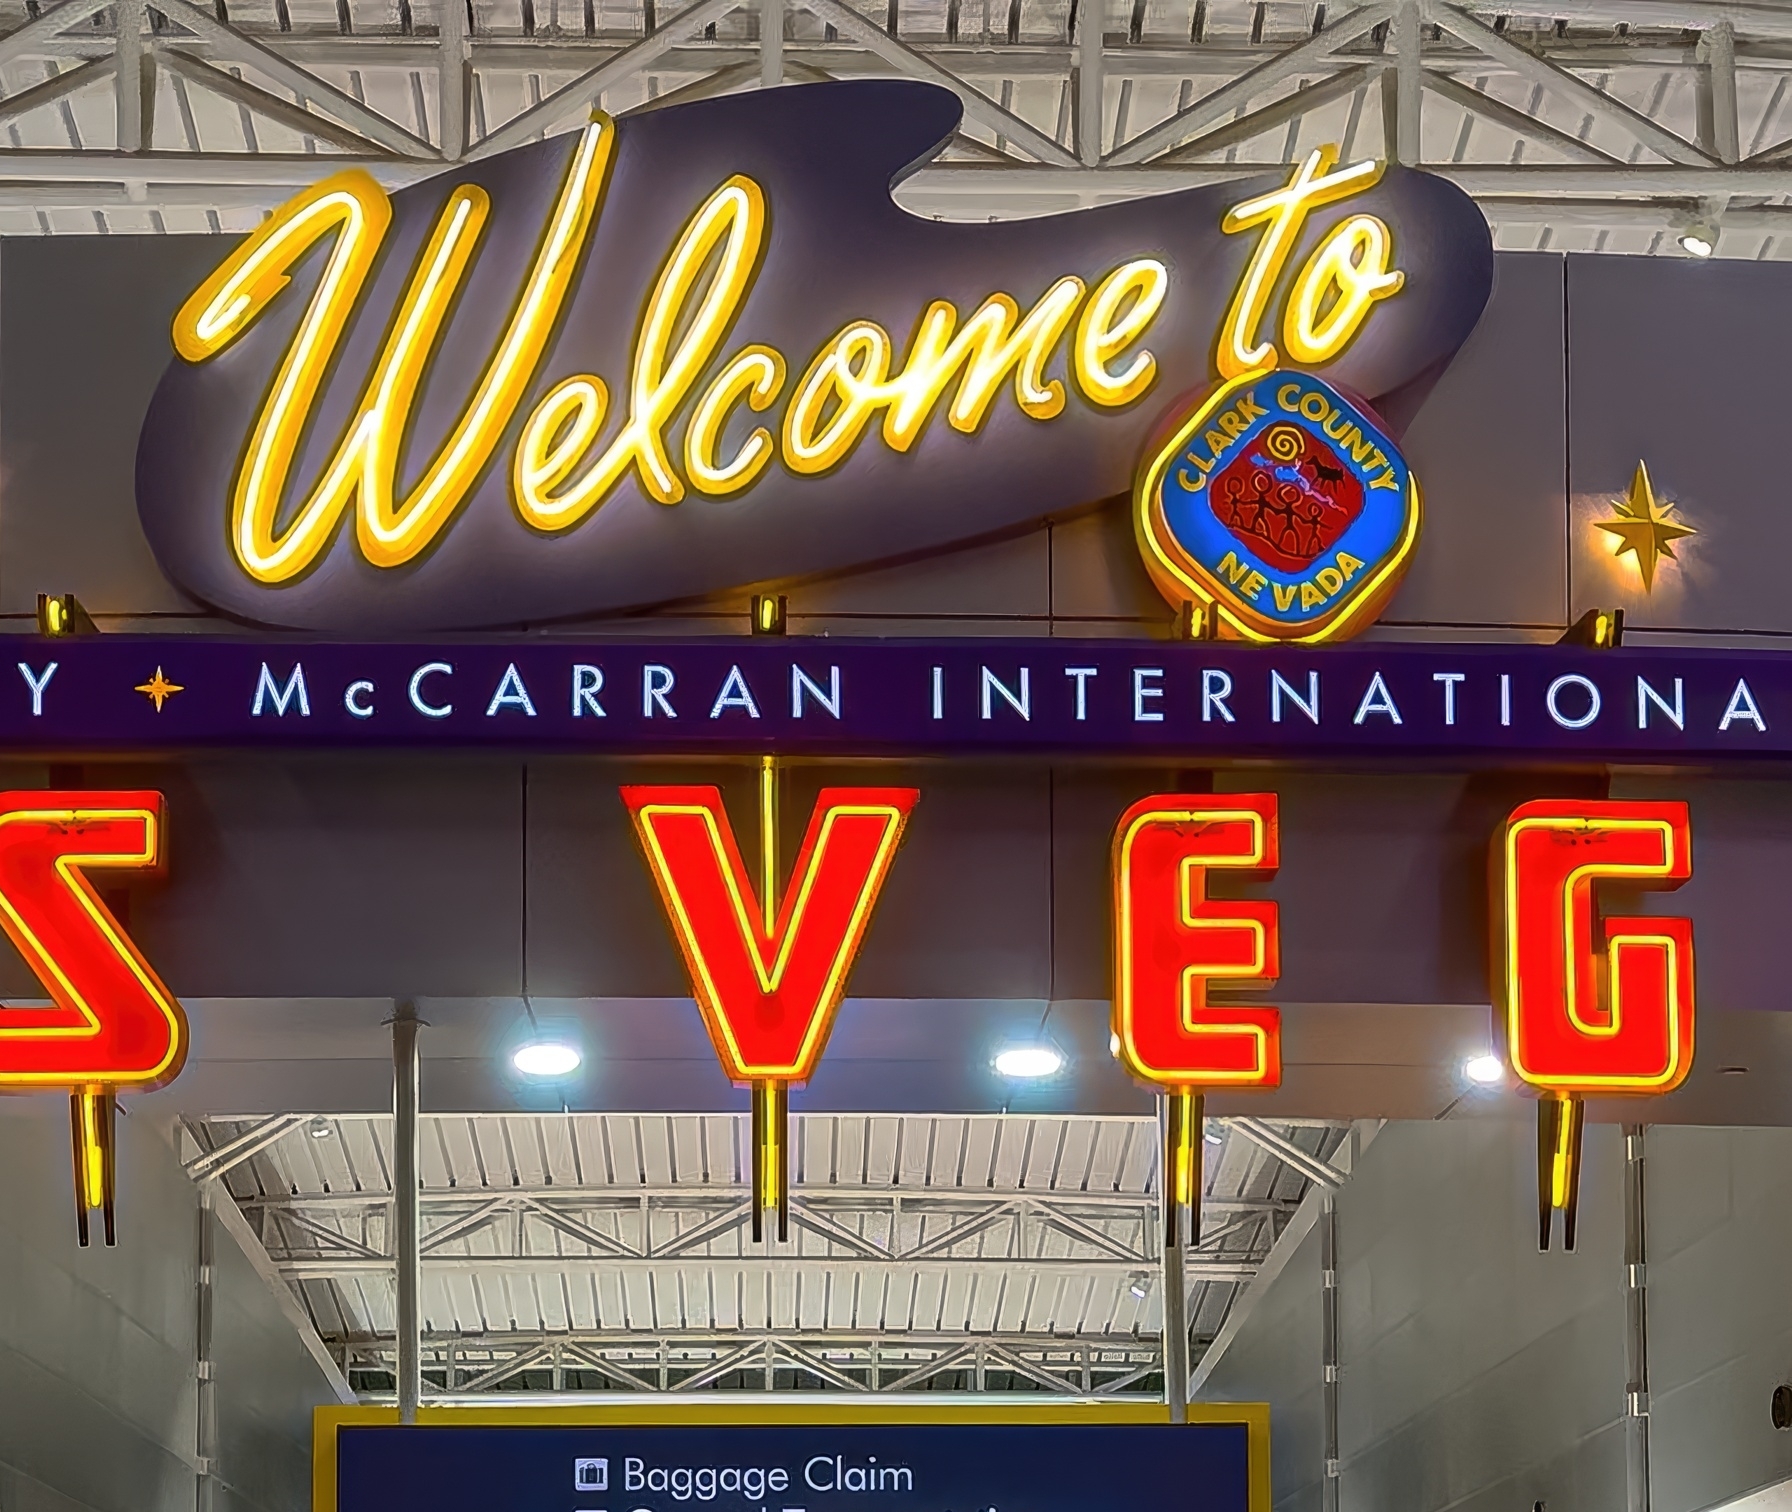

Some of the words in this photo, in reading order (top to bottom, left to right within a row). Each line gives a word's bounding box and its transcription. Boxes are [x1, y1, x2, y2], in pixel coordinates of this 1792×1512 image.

[172, 108, 1170, 585] Welcome
[1214, 143, 1405, 372] to
[1177, 390, 1271, 493] CLARK
[1276, 382, 1401, 493] COUNTY
[1216, 550, 1366, 613] NEVADA
[250, 660, 842, 721] McCARRAN
[623, 1456, 790, 1501] Baggage
[803, 1455, 914, 1493] Claim
